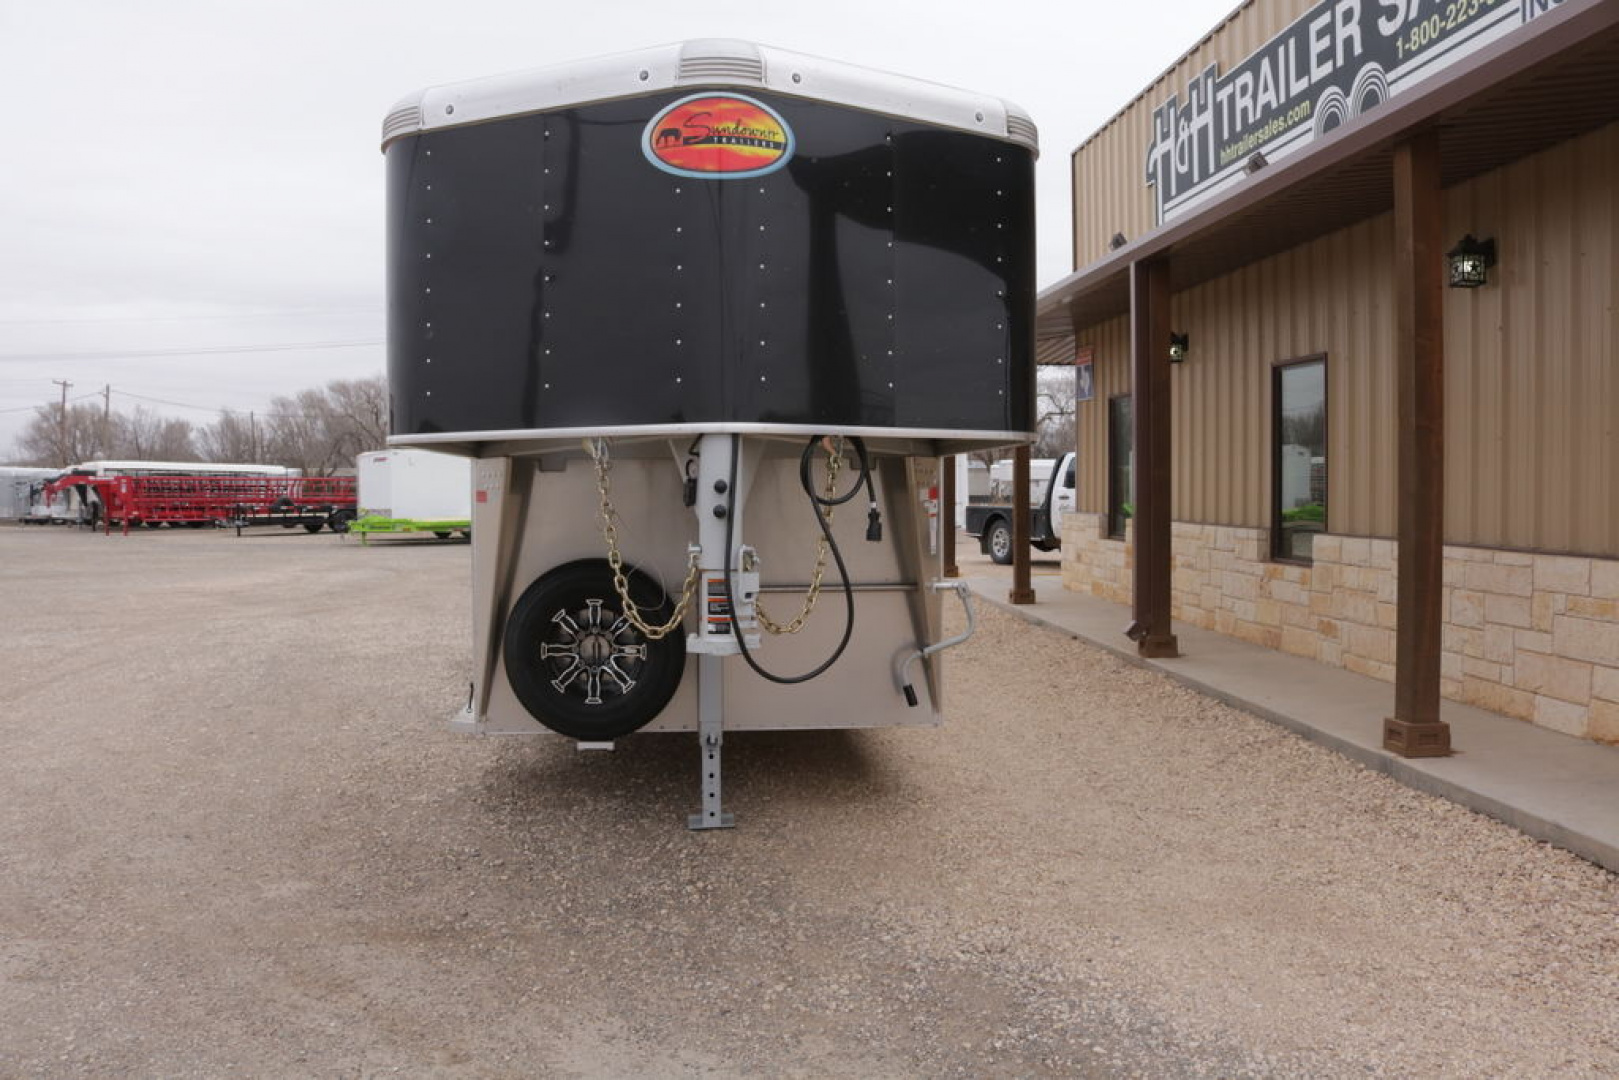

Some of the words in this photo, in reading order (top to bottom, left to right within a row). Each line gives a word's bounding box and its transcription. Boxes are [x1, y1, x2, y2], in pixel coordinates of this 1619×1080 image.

[1396, 0, 1495, 59] 1-800-223-
[1148, 76, 1215, 222] H&H
[1216, 0, 1363, 140] TRAILER
[1219, 100, 1311, 166] hhtrailersales.com
